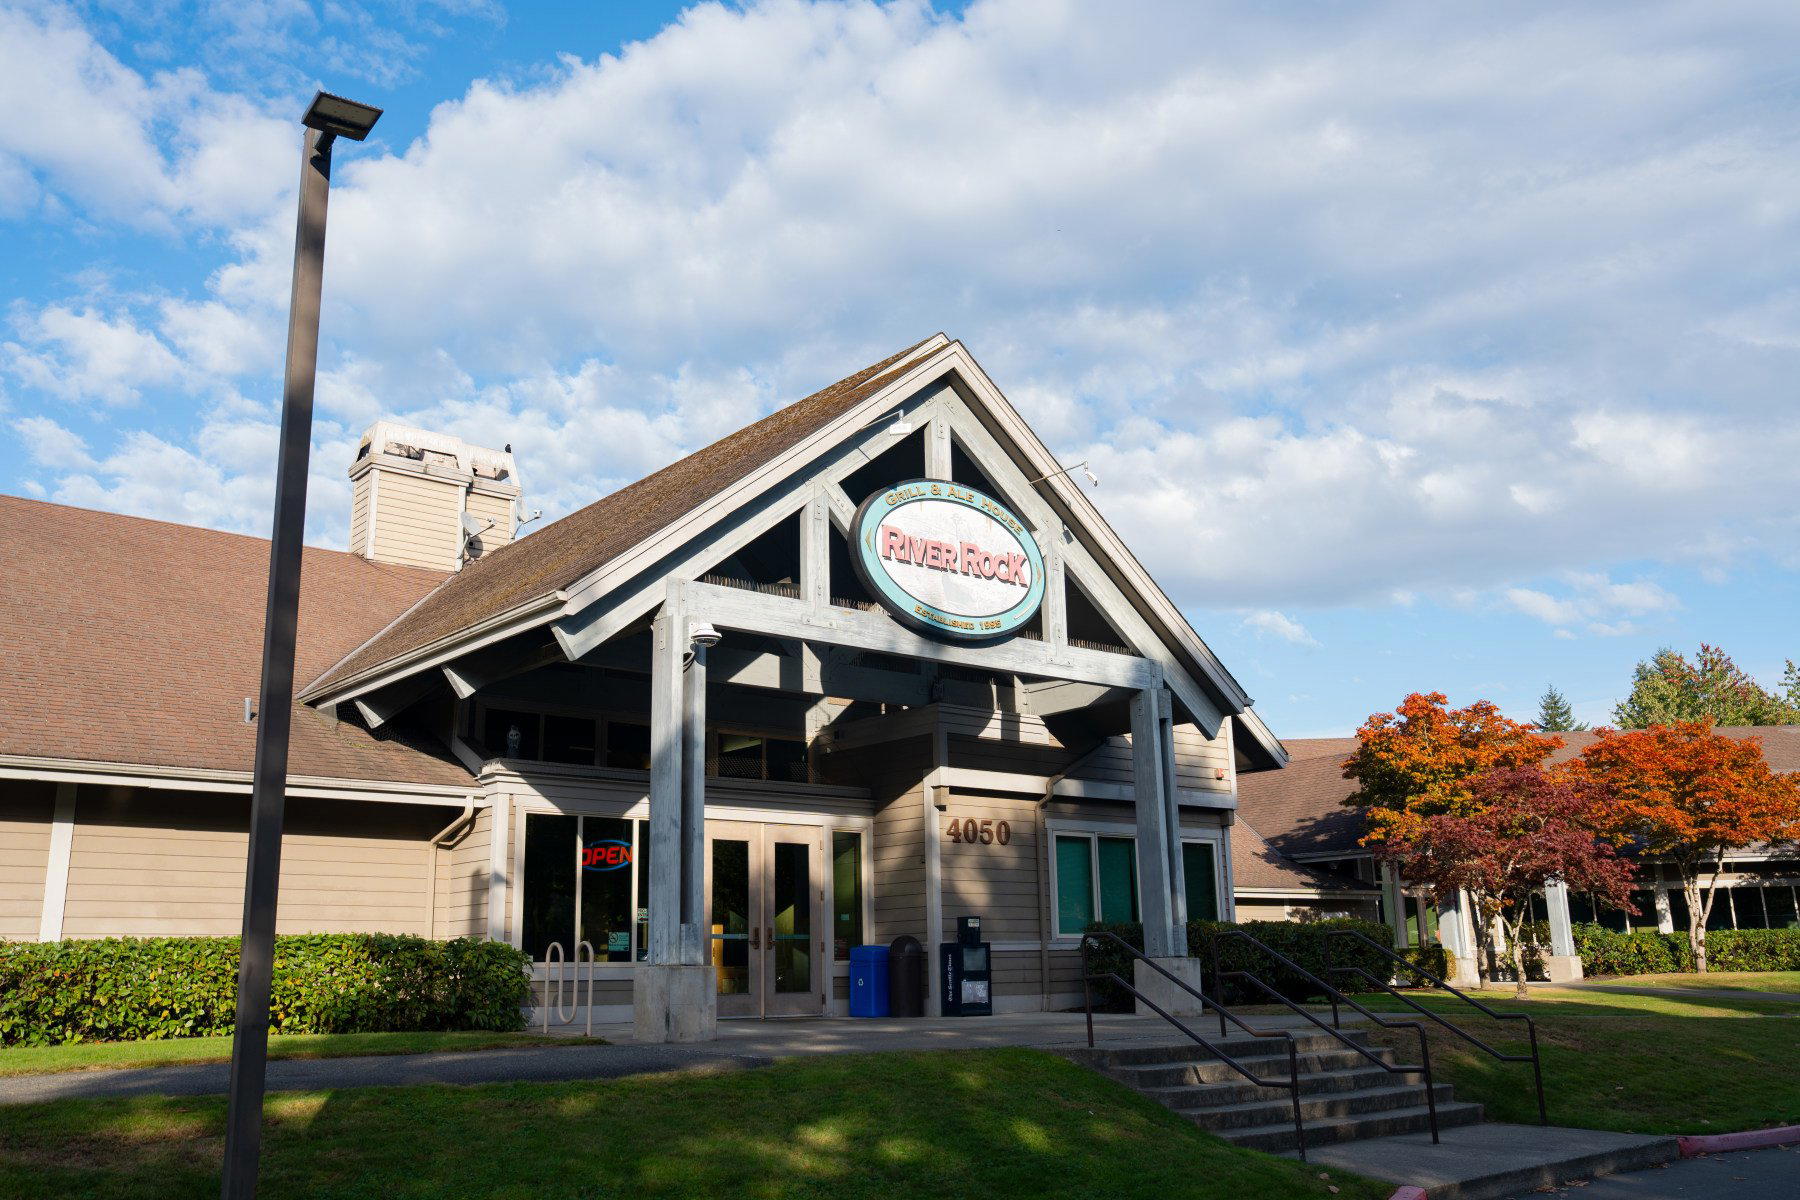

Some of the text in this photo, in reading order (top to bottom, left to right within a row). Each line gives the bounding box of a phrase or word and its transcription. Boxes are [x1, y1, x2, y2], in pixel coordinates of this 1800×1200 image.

[885, 484, 1024, 536] GRILL & ALE HOUSE
[882, 524, 1029, 588] RIVER ROCK
[914, 604, 975, 630] ESTABLISHED
[946, 818, 1011, 846] 4050
[582, 846, 633, 866] OPEN
